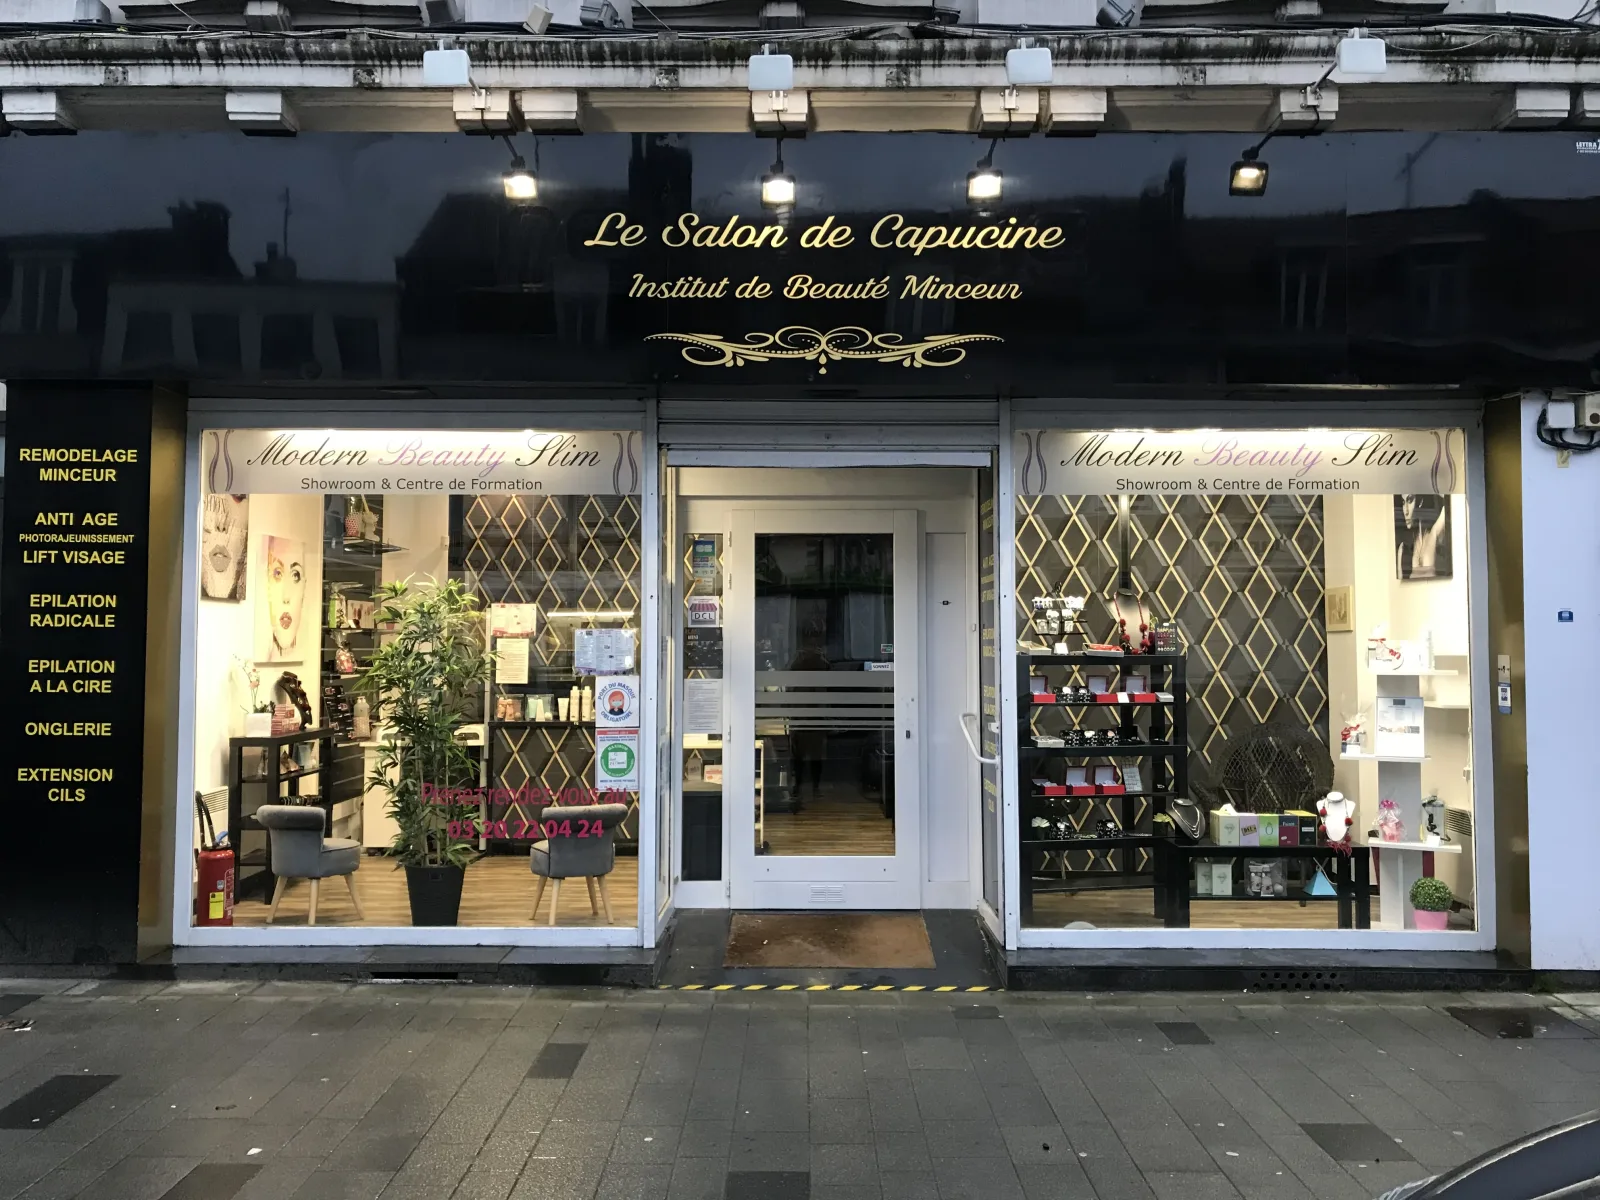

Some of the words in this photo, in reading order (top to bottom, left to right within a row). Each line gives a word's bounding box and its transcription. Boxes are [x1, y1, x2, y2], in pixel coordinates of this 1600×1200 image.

[584, 212, 646, 247] Le
[662, 212, 789, 249] Salon
[800, 215, 855, 249] de
[870, 213, 1065, 256] Capucine
[628, 273, 729, 299] Institut
[735, 276, 773, 299] de
[782, 274, 889, 299] Beauté
[900, 274, 1023, 300] Minceur
[19, 448, 138, 463] REMODELAGE
[247, 433, 369, 466] Modern
[377, 437, 506, 478] Beauty
[515, 433, 600, 467] Slim
[1060, 434, 1185, 467] Modern
[1193, 437, 1323, 478] Beauty
[1331, 433, 1418, 467] Slim
[39, 467, 117, 482] MINCEUR
[301, 477, 376, 490] Showroom
[381, 477, 392, 490] &
[396, 477, 444, 490] Centre
[448, 477, 466, 490] de
[471, 477, 543, 490] Formation
[1116, 478, 1192, 491] Showroom
[1197, 478, 1209, 490] &
[1213, 478, 1261, 490] Centre
[1265, 478, 1283, 490] de
[1288, 478, 1360, 490] Formation
[34, 512, 74, 526] ANTI
[82, 512, 118, 526] AGE
[18, 533, 135, 544] PHOTORAJEUNISSEMENT
[23, 550, 59, 564] LIFT
[62, 550, 126, 565] VISAGE
[29, 593, 117, 608] EPILATION
[29, 613, 116, 628] RADICALE
[694, 612, 713, 620] DCL
[28, 659, 116, 674] EPILATION
[29, 680, 43, 693] A
[46, 680, 69, 693] LA
[72, 679, 112, 694] CIRE
[617, 682, 636, 699] MASQUE
[600, 710, 633, 723] OBLIGATOIRE
[24, 722, 112, 736] ONGLERIE
[17, 768, 114, 782] EXTENSION
[48, 788, 86, 802] CILS
[604, 787, 627, 804] au
[448, 820, 475, 839] 03
[481, 820, 508, 839] 20
[513, 819, 540, 839] 22
[545, 820, 572, 838] 04
[577, 819, 604, 838] 24
